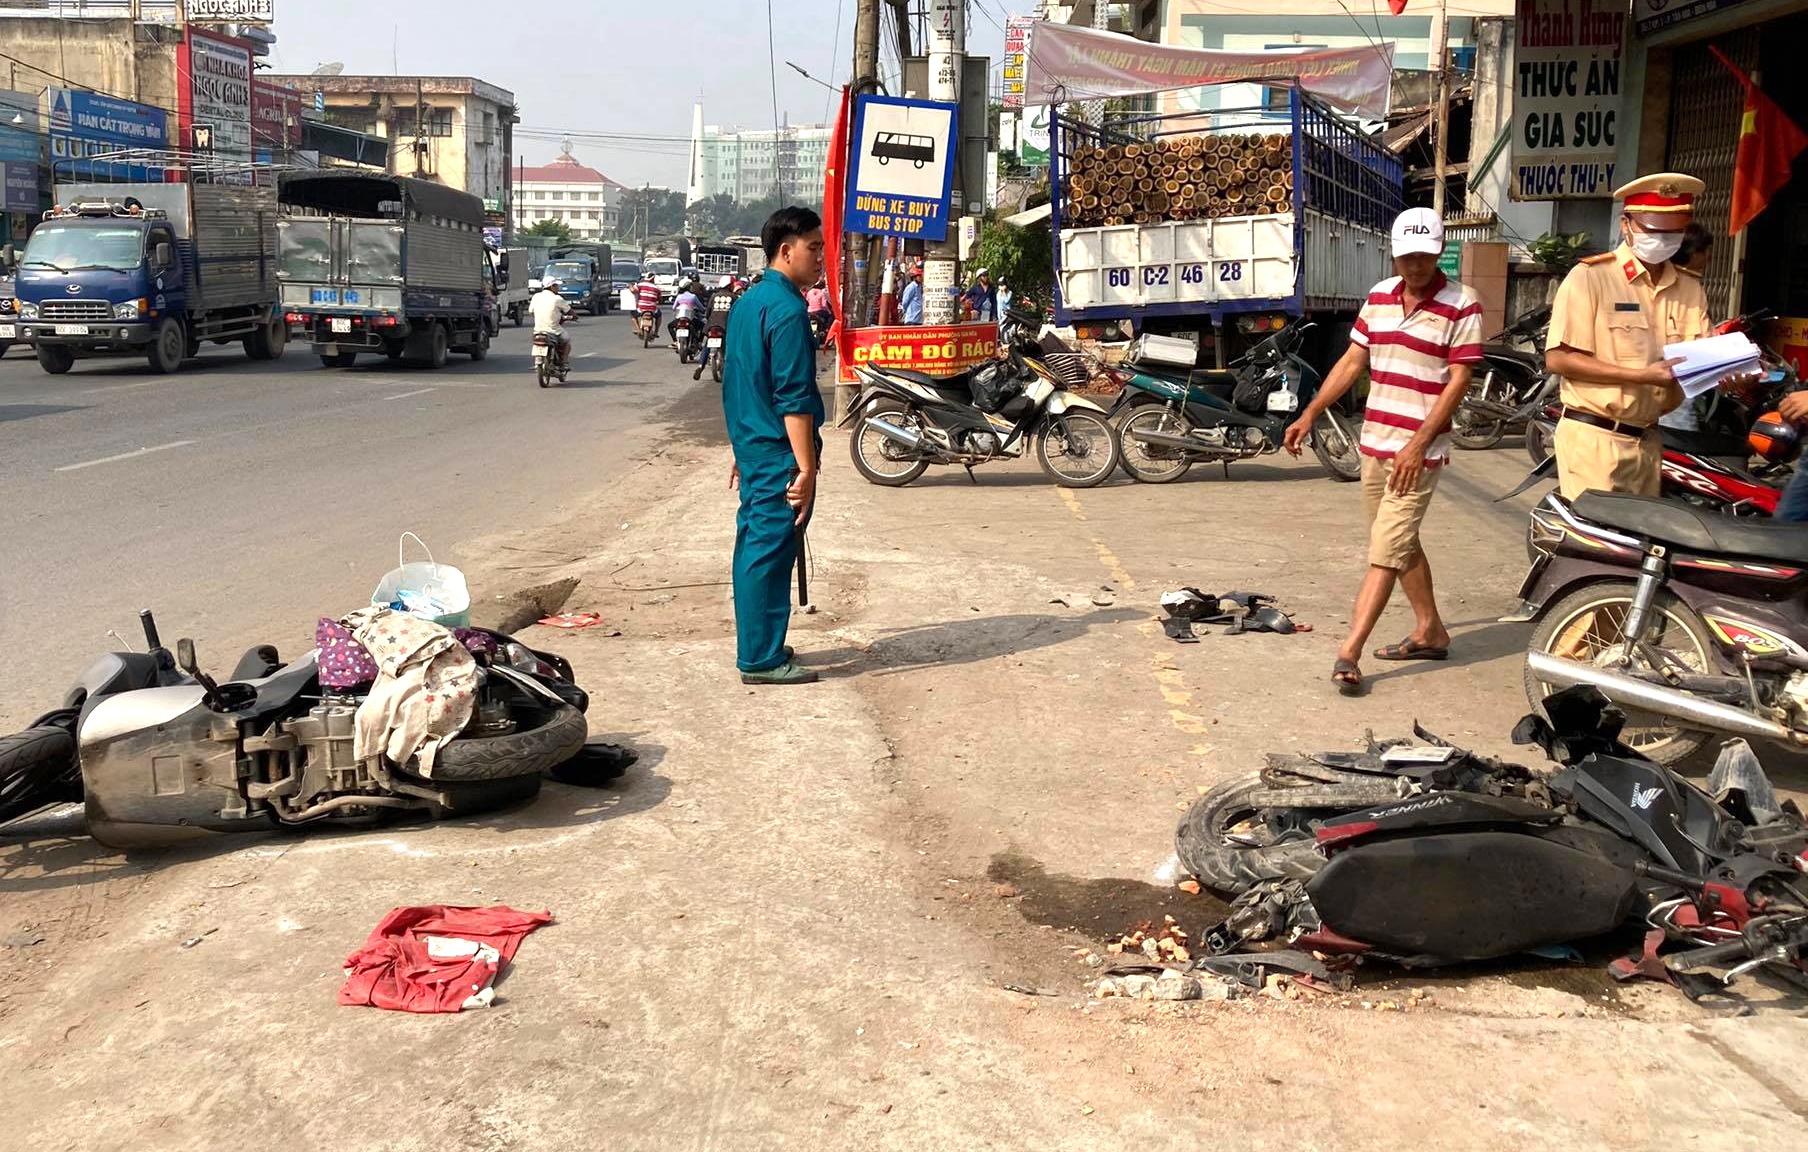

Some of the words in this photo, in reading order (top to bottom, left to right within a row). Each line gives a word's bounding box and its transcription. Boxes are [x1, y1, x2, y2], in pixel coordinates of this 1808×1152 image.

[1519, 53, 1578, 98] THỨC
[1584, 52, 1620, 96] ĂN
[1525, 112, 1565, 149] GIA
[1573, 103, 1615, 147] SÚC
[1519, 155, 1566, 195] THUỐC
[856, 194, 887, 212] DỪNG
[889, 199, 905, 214] XE
[908, 200, 939, 218] BUÝT
[868, 214, 891, 230] BUS
[894, 217, 923, 233] STOP
[1403, 225, 1430, 235] FILA
[1109, 268, 1130, 287] 60
[1181, 265, 1203, 283] 46
[1220, 262, 1242, 281] 28
[903, 332, 921, 340] NHÂN
[853, 339, 913, 362] CẤM
[921, 339, 957, 359] ĐỔ
[962, 339, 994, 357] RÁC
